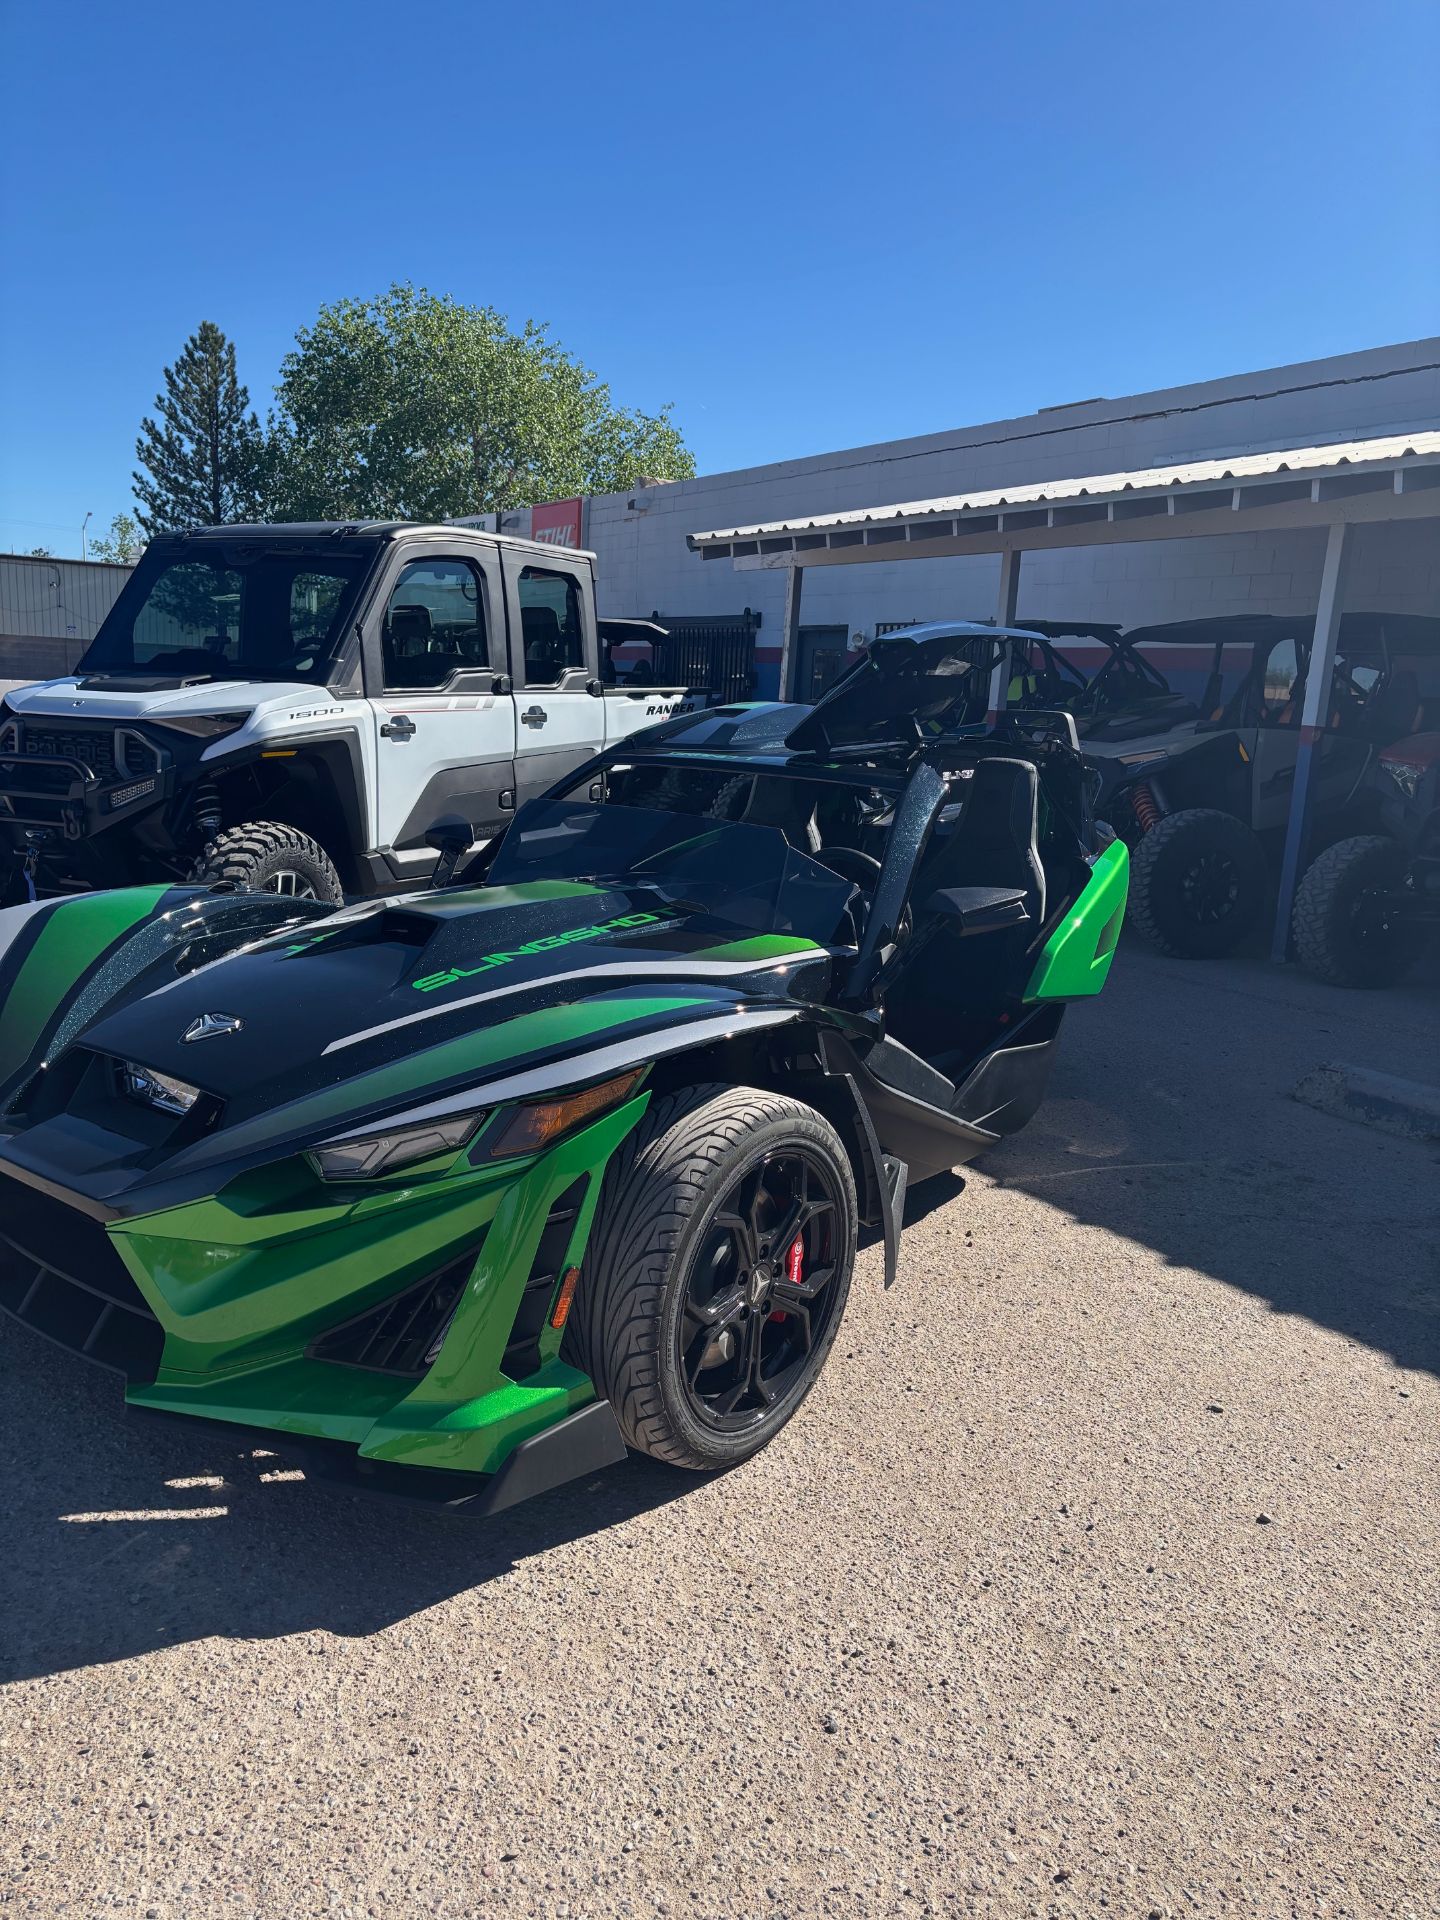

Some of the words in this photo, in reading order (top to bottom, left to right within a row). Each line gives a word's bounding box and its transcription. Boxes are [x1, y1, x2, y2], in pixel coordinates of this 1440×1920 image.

[535, 525, 575, 547] STIHL
[289, 707, 344, 719] 1500
[646, 703, 695, 715] RANGER
[412, 907, 677, 992] SLINGSHOT
